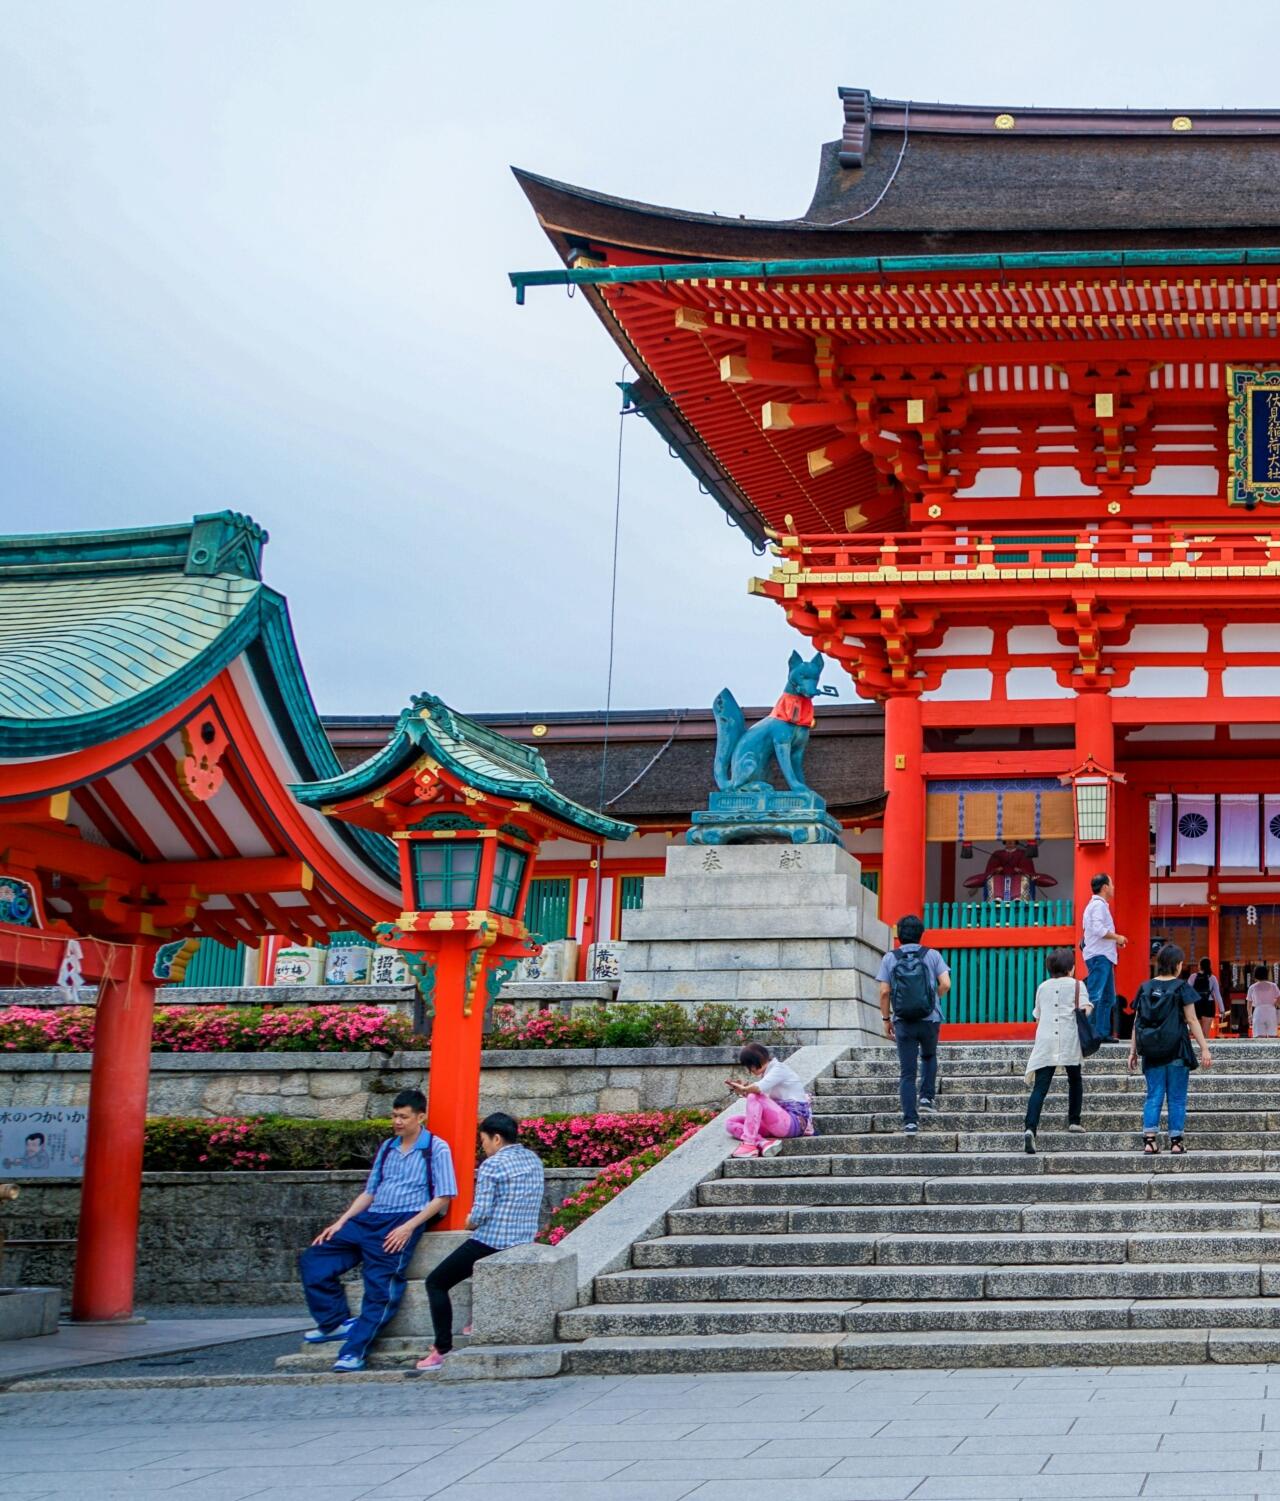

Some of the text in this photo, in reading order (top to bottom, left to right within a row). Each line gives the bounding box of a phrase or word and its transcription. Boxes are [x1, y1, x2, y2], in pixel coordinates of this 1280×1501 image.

[0, 1110, 88, 1124] 水のつかいか
